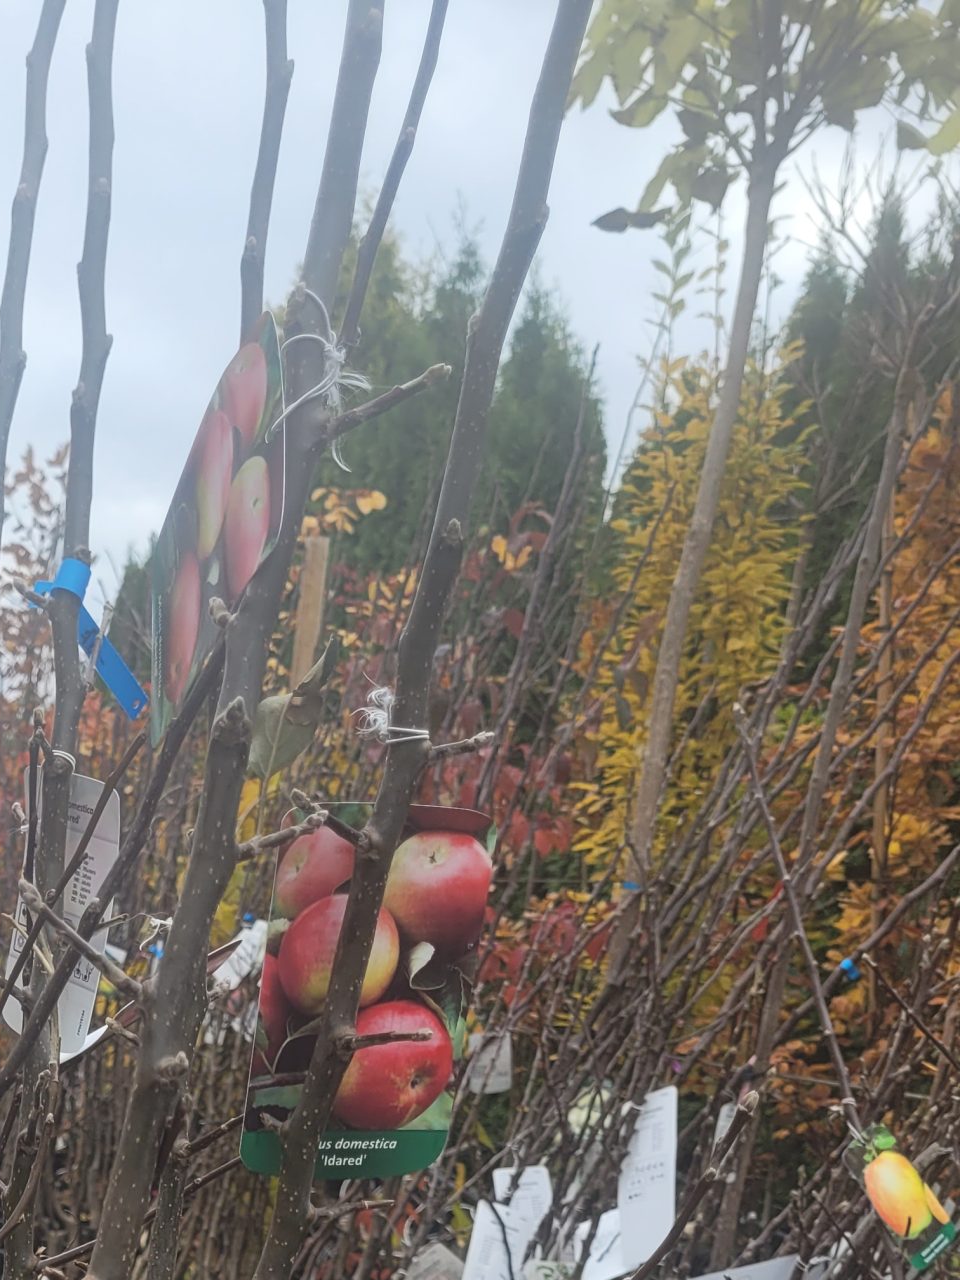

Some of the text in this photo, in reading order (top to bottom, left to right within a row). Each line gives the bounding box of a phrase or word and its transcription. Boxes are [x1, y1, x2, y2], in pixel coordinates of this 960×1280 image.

[67, 801, 94, 815] omestica
[334, 1137, 397, 1150] domestica
[321, 1154, 367, 1167] 'Idared'
